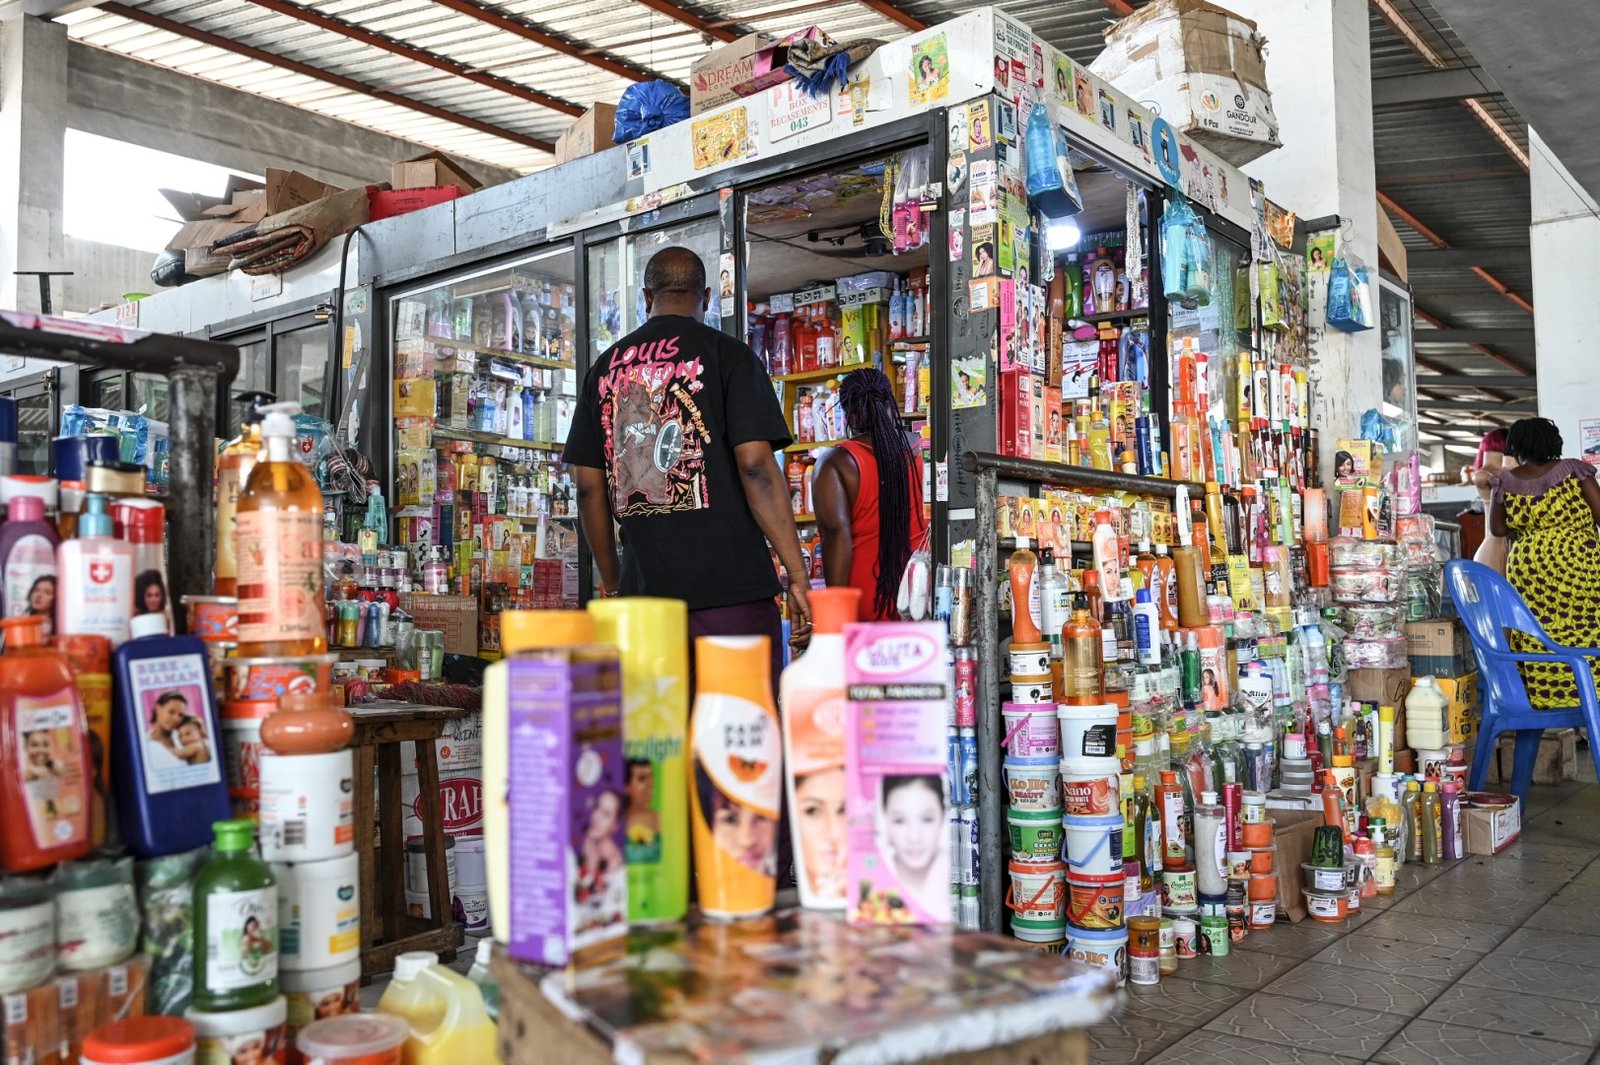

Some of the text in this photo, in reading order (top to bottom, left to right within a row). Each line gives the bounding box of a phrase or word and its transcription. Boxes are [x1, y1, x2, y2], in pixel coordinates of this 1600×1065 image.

[708, 59, 753, 86] DREAM
[790, 99, 808, 110] BOX
[790, 117, 809, 131] 043
[1208, 119, 1219, 128] Pcs
[1226, 110, 1257, 124] GANDOUR
[608, 336, 681, 370] LOUIS
[866, 641, 923, 658] GLUTA
[137, 661, 177, 675] BEBE
[138, 669, 200, 687] MAMAN
[850, 685, 884, 699] TOTAL
[725, 735, 763, 748] PAW
[1063, 783, 1091, 796] Nano
